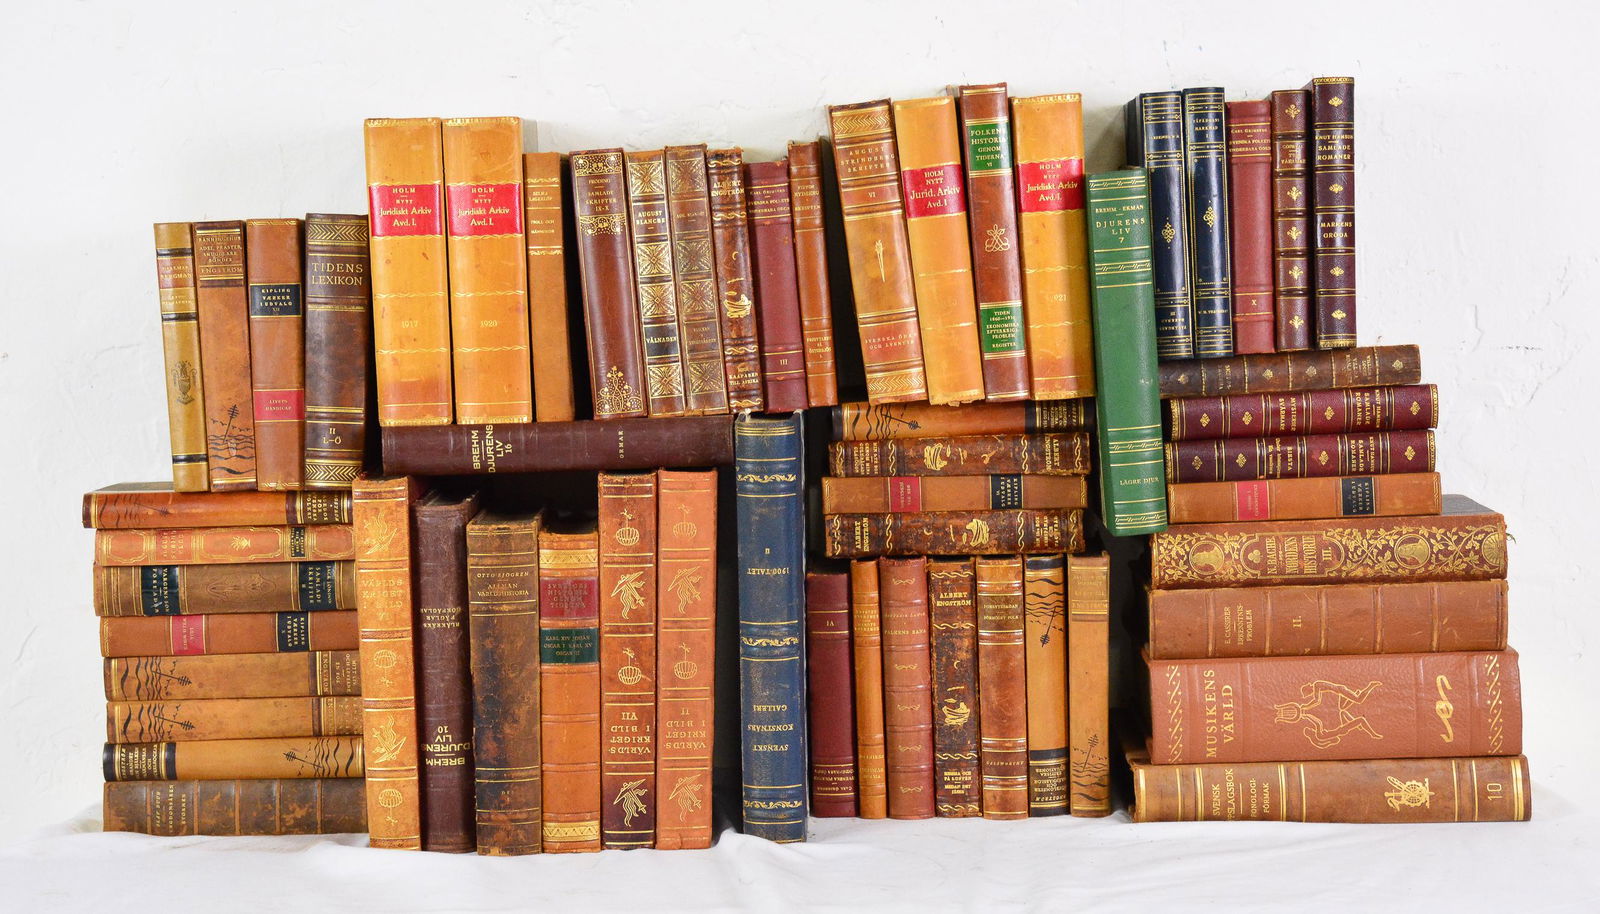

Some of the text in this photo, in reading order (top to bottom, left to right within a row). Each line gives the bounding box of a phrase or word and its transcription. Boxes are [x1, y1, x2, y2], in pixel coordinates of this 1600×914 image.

[849, 147, 885, 156] AUGUST
[840, 154, 895, 166] STRINDBERG
[848, 163, 890, 173] SKRIFTER
[924, 170, 944, 178] HOLM
[926, 178, 944, 186] NYTT
[1058, 181, 1078, 189] Arkiv
[910, 186, 960, 200] Jurid. Arkiv
[380, 208, 408, 216] Juridiskt
[458, 208, 486, 218] Juridiskt
[1122, 204, 1144, 212] EKMAN
[638, 210, 662, 218] AUGUST
[470, 218, 488, 226] Avd.
[1096, 218, 1145, 228] DJURENS
[312, 262, 363, 273] TIDENS
[312, 276, 362, 286] LEXIKON
[402, 320, 418, 328] 1917
[480, 320, 498, 328] 1920
[472, 430, 480, 470] BREHM
[486, 424, 496, 472] DJURENS
[496, 440, 504, 458] LIV
[504, 444, 512, 454] 16
[854, 520, 862, 549] ALBERT
[1266, 536, 1278, 574] N. BACHE
[1284, 536, 1298, 574] NORDENS
[1302, 536, 1317, 574] HISTORIE
[1322, 546, 1332, 560] III.
[746, 568, 790, 576] 1900-TALET
[1292, 616, 1302, 628] II.
[752, 704, 788, 712] GALLERI
[621, 712, 638, 720] VII
[1205, 669, 1216, 758] MUSIKENS
[1222, 684, 1234, 744] VÄRLD
[666, 720, 694, 728] BILD
[748, 723, 794, 732] KONSTNÄRS
[438, 726, 448, 734] 10
[666, 730, 706, 738] KRIGET
[434, 734, 452, 742] LIV
[421, 742, 470, 752] DJURENS
[752, 744, 788, 752] SVENSKT
[426, 757, 465, 766] BREHM
[1488, 782, 1502, 800] 10
[1212, 784, 1220, 816] SVENSK
[1262, 782, 1270, 813] FÖRMAK
